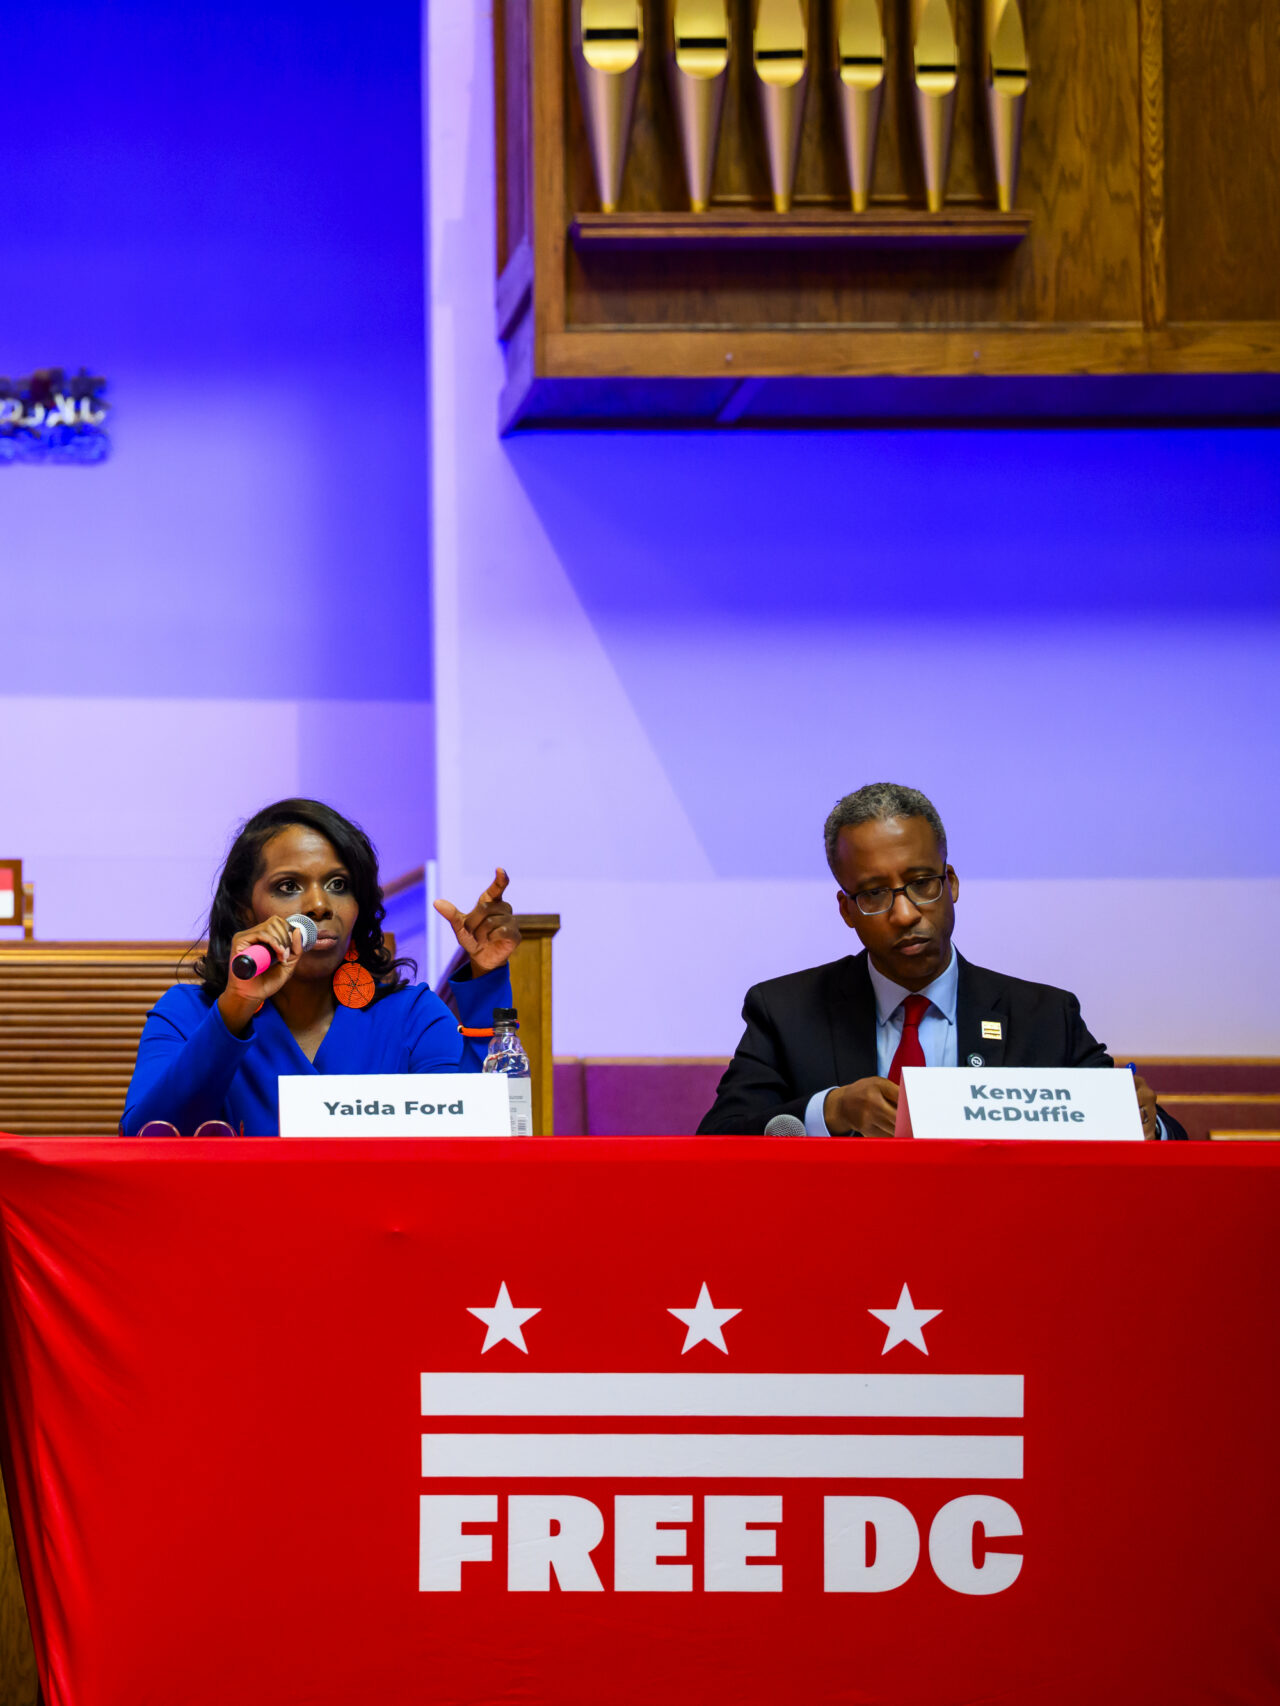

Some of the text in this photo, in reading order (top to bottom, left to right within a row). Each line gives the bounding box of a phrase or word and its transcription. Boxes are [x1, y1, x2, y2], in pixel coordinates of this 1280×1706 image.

[970, 1084, 1072, 1104] Kenyan
[323, 1099, 464, 1116] Yaida Ford
[963, 1105, 1086, 1123] McDuffie
[419, 1494, 1024, 1596] FREE DC
